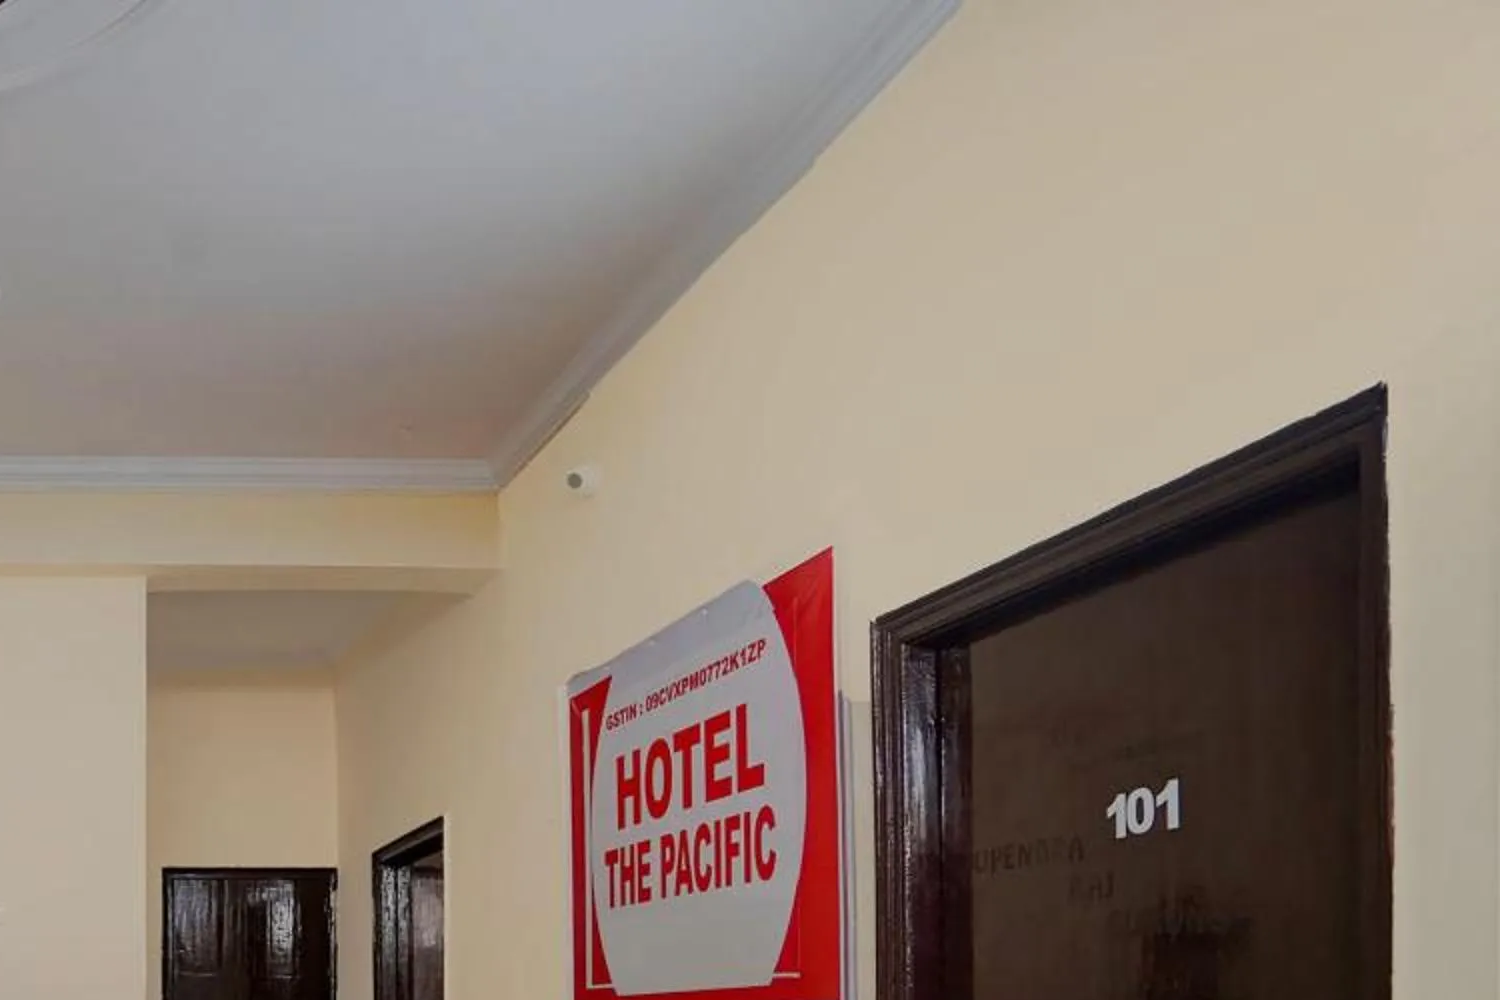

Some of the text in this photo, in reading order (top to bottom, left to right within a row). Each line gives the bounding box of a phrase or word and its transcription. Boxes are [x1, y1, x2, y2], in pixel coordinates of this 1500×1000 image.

[605, 704, 637, 731] GSTIN
[615, 703, 765, 830] HOTEL
[1106, 778, 1180, 839] 101
[604, 805, 776, 909] THE PACIFIC
